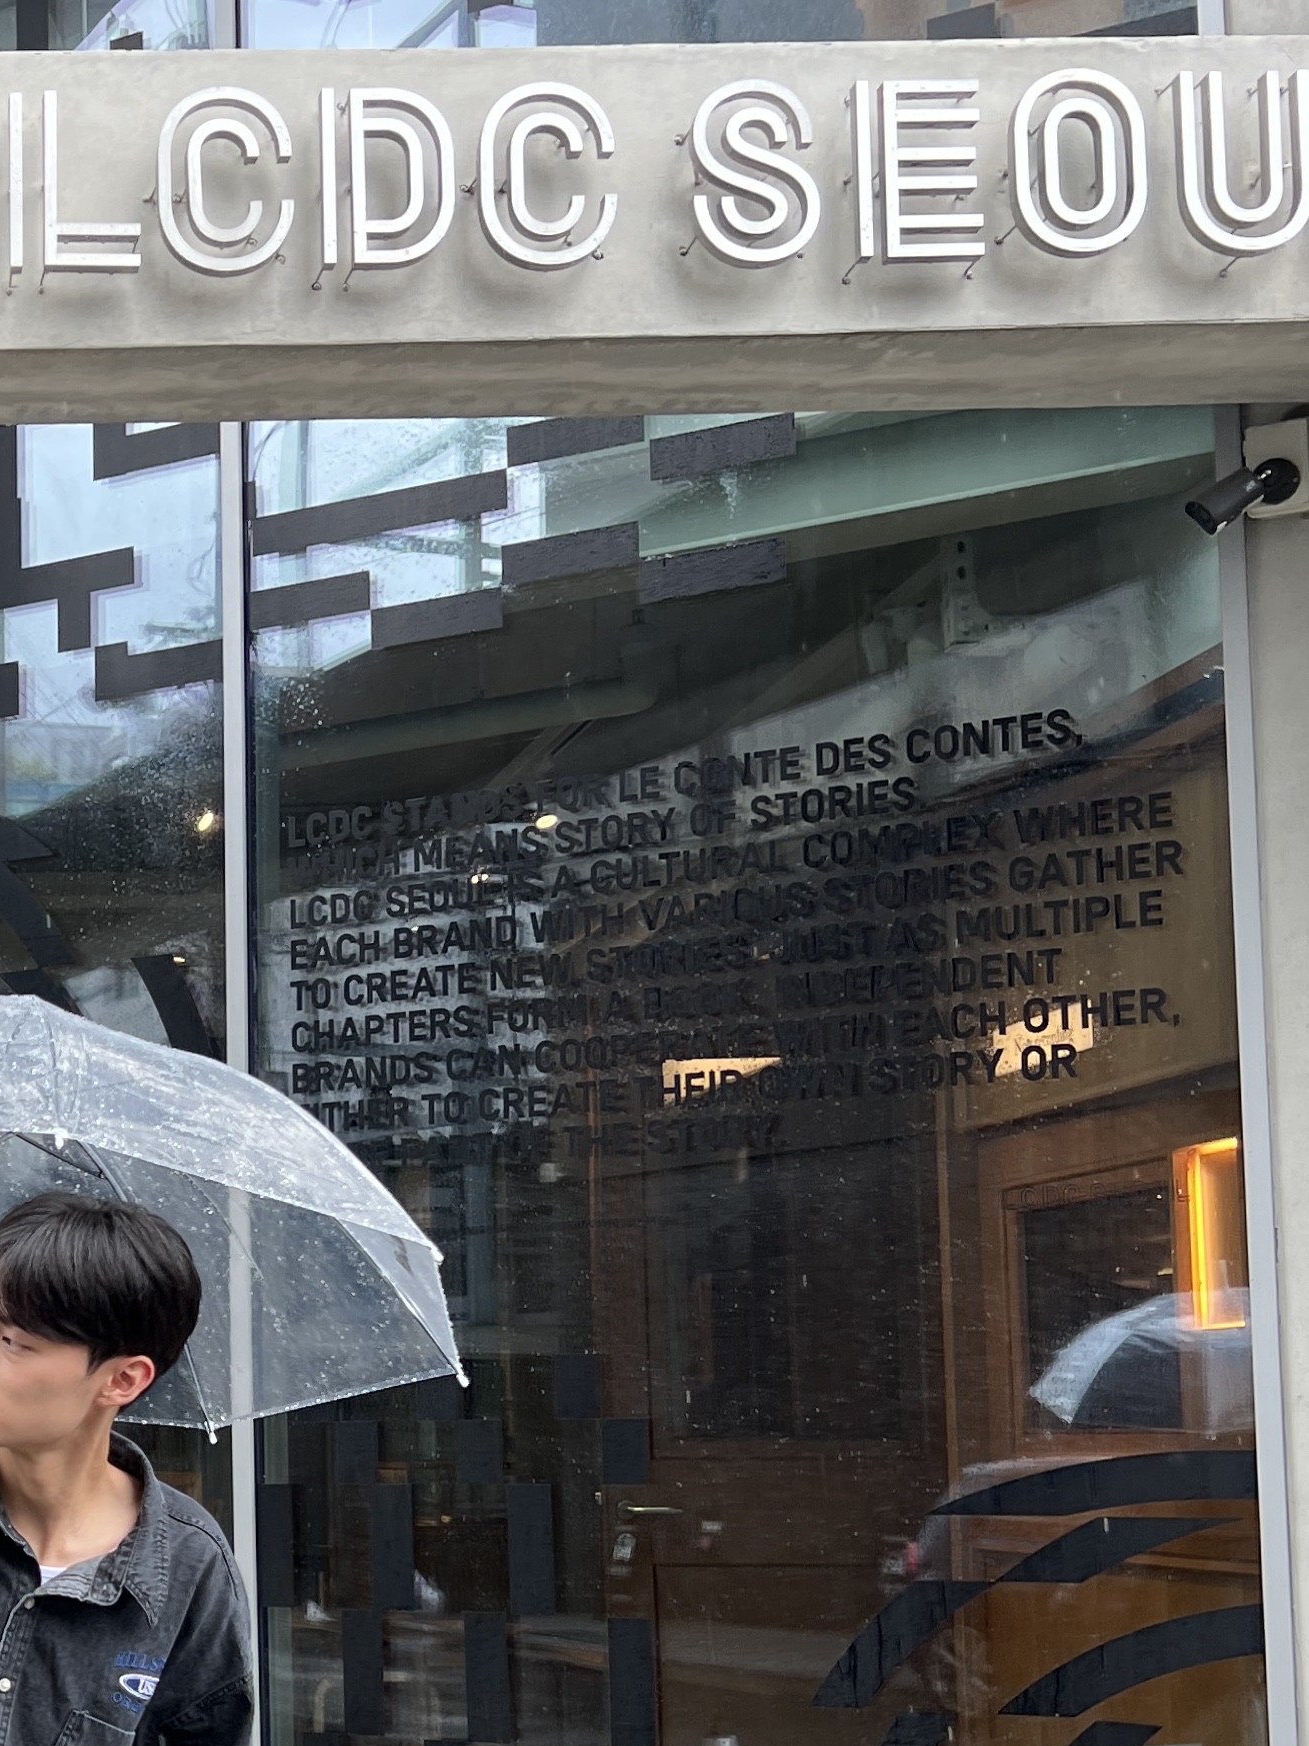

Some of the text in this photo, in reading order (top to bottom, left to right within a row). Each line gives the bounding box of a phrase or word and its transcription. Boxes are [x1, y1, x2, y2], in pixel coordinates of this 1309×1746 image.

[7, 81, 618, 274] LCDC
[288, 806, 374, 848] LCDC
[536, 773, 613, 813] FOR
[619, 765, 661, 802] LE
[674, 745, 802, 796] CONTE
[815, 733, 891, 777] DES
[905, 708, 1084, 764] CONTES,
[413, 825, 549, 873] MEANS
[554, 806, 676, 855] STORY
[691, 799, 736, 837] OF
[290, 889, 374, 930] LCDC
[386, 870, 494, 917] SEOUL
[551, 865, 576, 899] A
[590, 837, 789, 893] CULTURAL
[802, 809, 1005, 870] COMPLEX
[1012, 790, 1173, 846] WHERE
[290, 838, 1185, 972] EACH BRAND WITH VARIOUS STORIES GATHER
[290, 976, 333, 1012] TO
[343, 960, 477, 1006] CREATE
[490, 948, 573, 992] NEW
[887, 911, 947, 954] AS
[955, 888, 1164, 946] MULTIPLE
[290, 1004, 479, 1053] CHAPTERS
[487, 992, 590, 1035] FORM
[777, 947, 1063, 1010] INDEPENDENT
[292, 1051, 436, 1094] BRANDS
[446, 1041, 522, 1082] CAN
[896, 1000, 1008, 1047] EACH
[1022, 986, 1181, 1034] OTHER,
[303, 1097, 408, 1134] ITHER
[422, 1090, 468, 1125] TO
[478, 1075, 631, 1122] CREATE
[632, 1065, 740, 1110] THEIR
[869, 1047, 1005, 1095] STORY
[1020, 1043, 1079, 1082] OR
